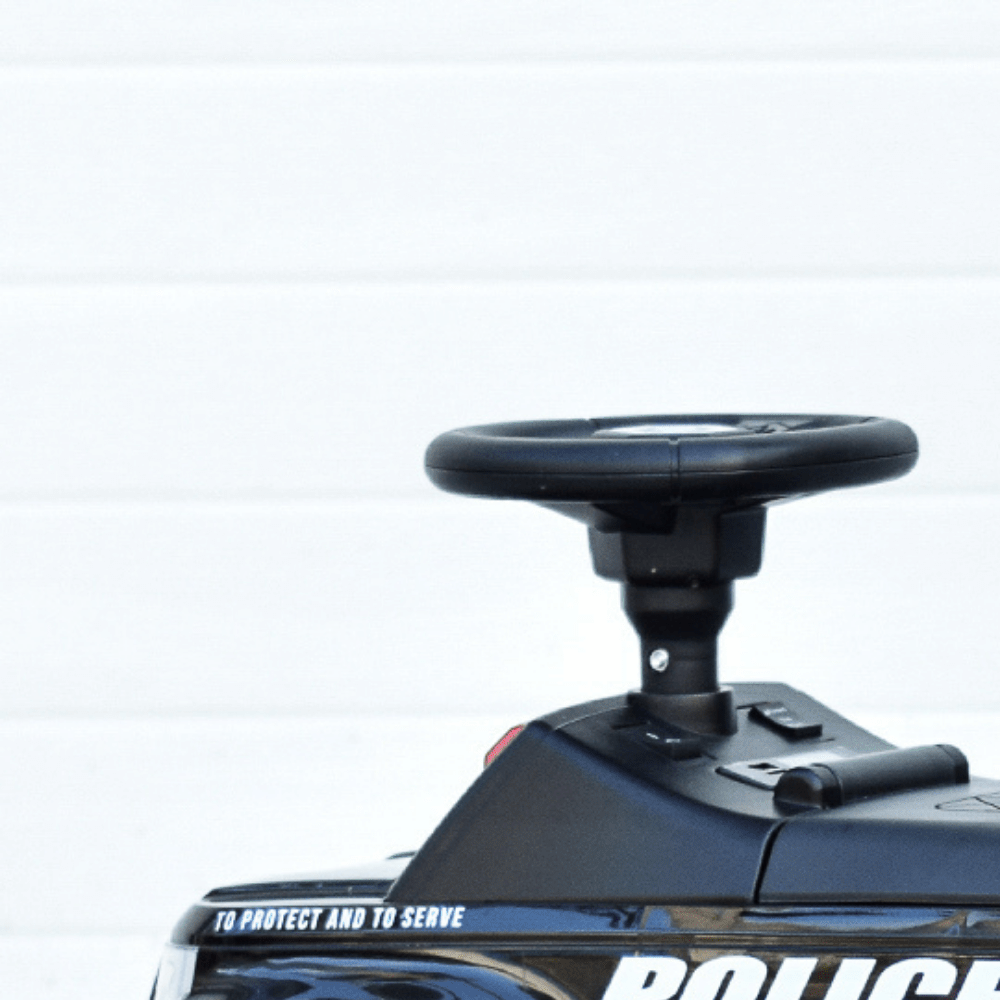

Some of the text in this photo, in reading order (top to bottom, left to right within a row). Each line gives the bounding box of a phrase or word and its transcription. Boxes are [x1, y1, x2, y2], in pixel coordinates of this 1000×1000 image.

[214, 906, 466, 932] TO PROTECT AND TO SERVE
